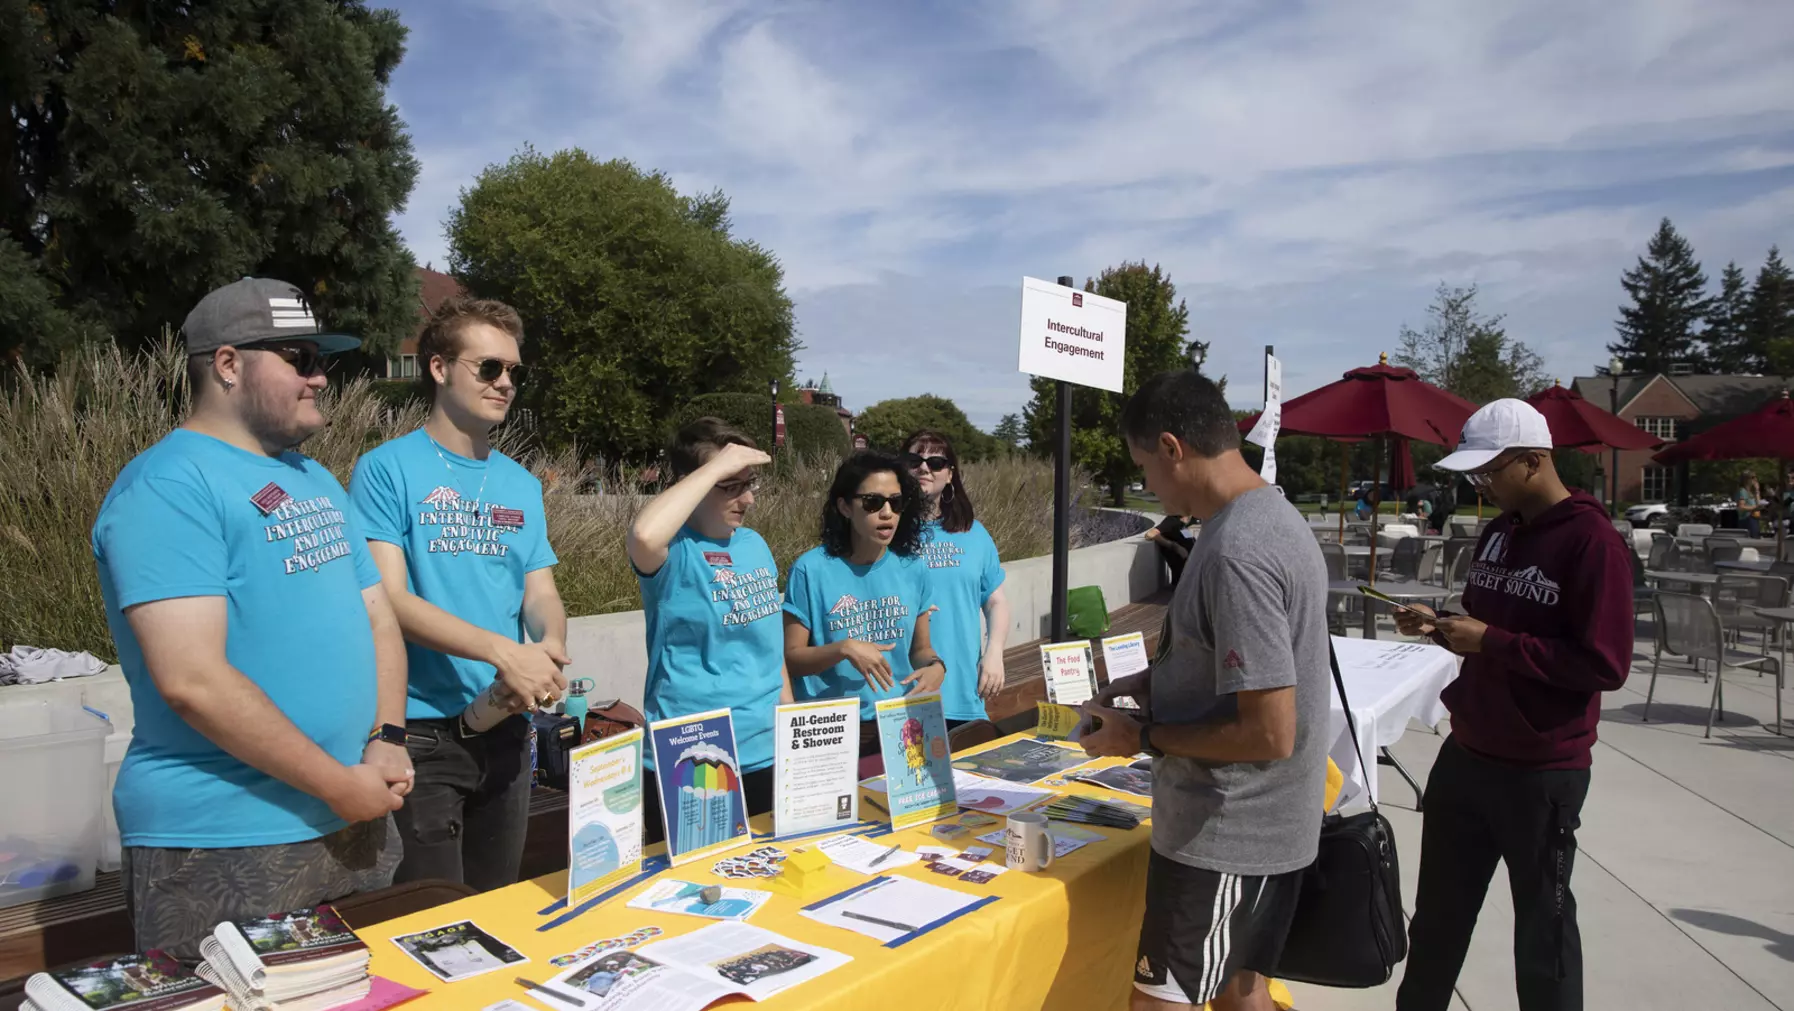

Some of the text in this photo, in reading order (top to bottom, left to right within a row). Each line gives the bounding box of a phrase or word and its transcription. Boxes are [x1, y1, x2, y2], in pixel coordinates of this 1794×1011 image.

[1047, 318, 1104, 343] Intercultural
[1044, 336, 1104, 361] Engagement
[271, 499, 320, 522] CENTER
[434, 499, 480, 512] CENTER
[440, 526, 500, 541] AND IVIC
[294, 532, 319, 554] AND
[428, 538, 509, 557] ENGAGMENT
[752, 590, 776, 606] CIVIC
[1504, 579, 1559, 605] SOUND
[839, 596, 901, 617] CENTER FOR
[848, 618, 897, 638] AND CIVIC
[1056, 654, 1080, 665] The Food
[1061, 668, 1080, 677] Pantry
[790, 712, 848, 727] All-Gender
[668, 729, 719, 746] Welcome Events
[681, 723, 703, 735] LGBTQ
[792, 725, 845, 738] Restroom
[791, 736, 844, 750] & Shower
[403, 925, 467, 943] ENGAGE
